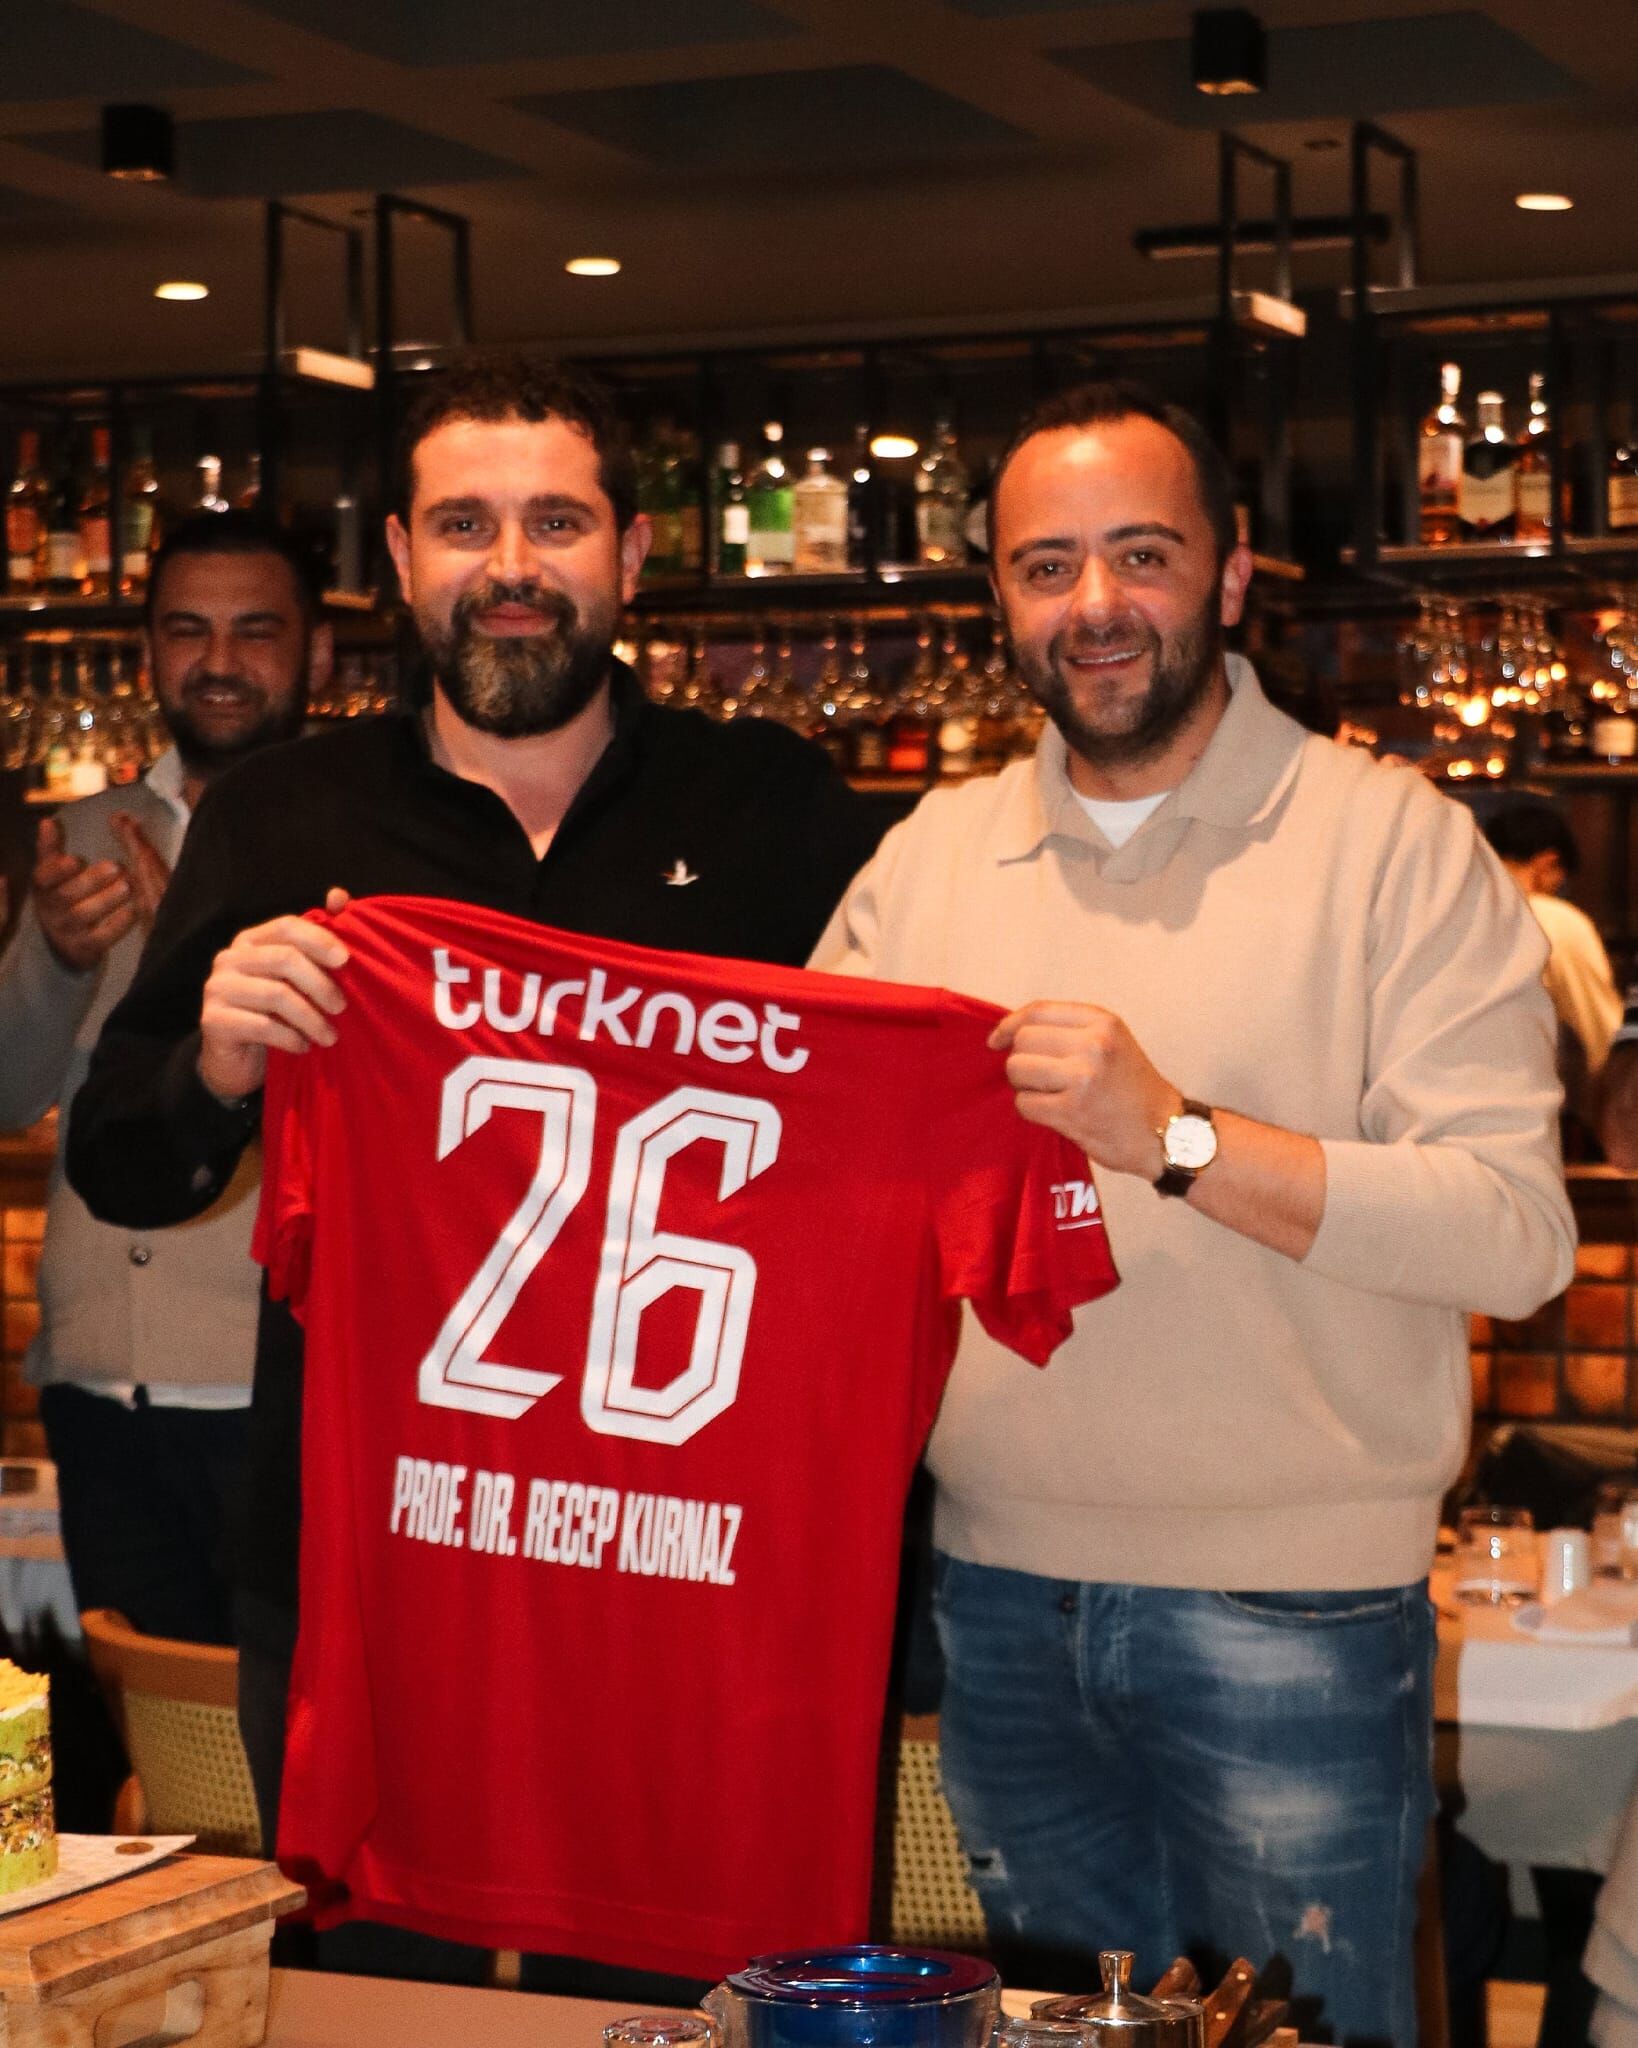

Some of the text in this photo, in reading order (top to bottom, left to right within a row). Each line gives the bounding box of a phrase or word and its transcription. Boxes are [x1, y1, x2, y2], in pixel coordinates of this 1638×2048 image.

[432, 948, 810, 1074] turknet
[418, 1055, 782, 1446] 26
[390, 1455, 743, 1586] PROF. DR. RECEP KURNAZ
